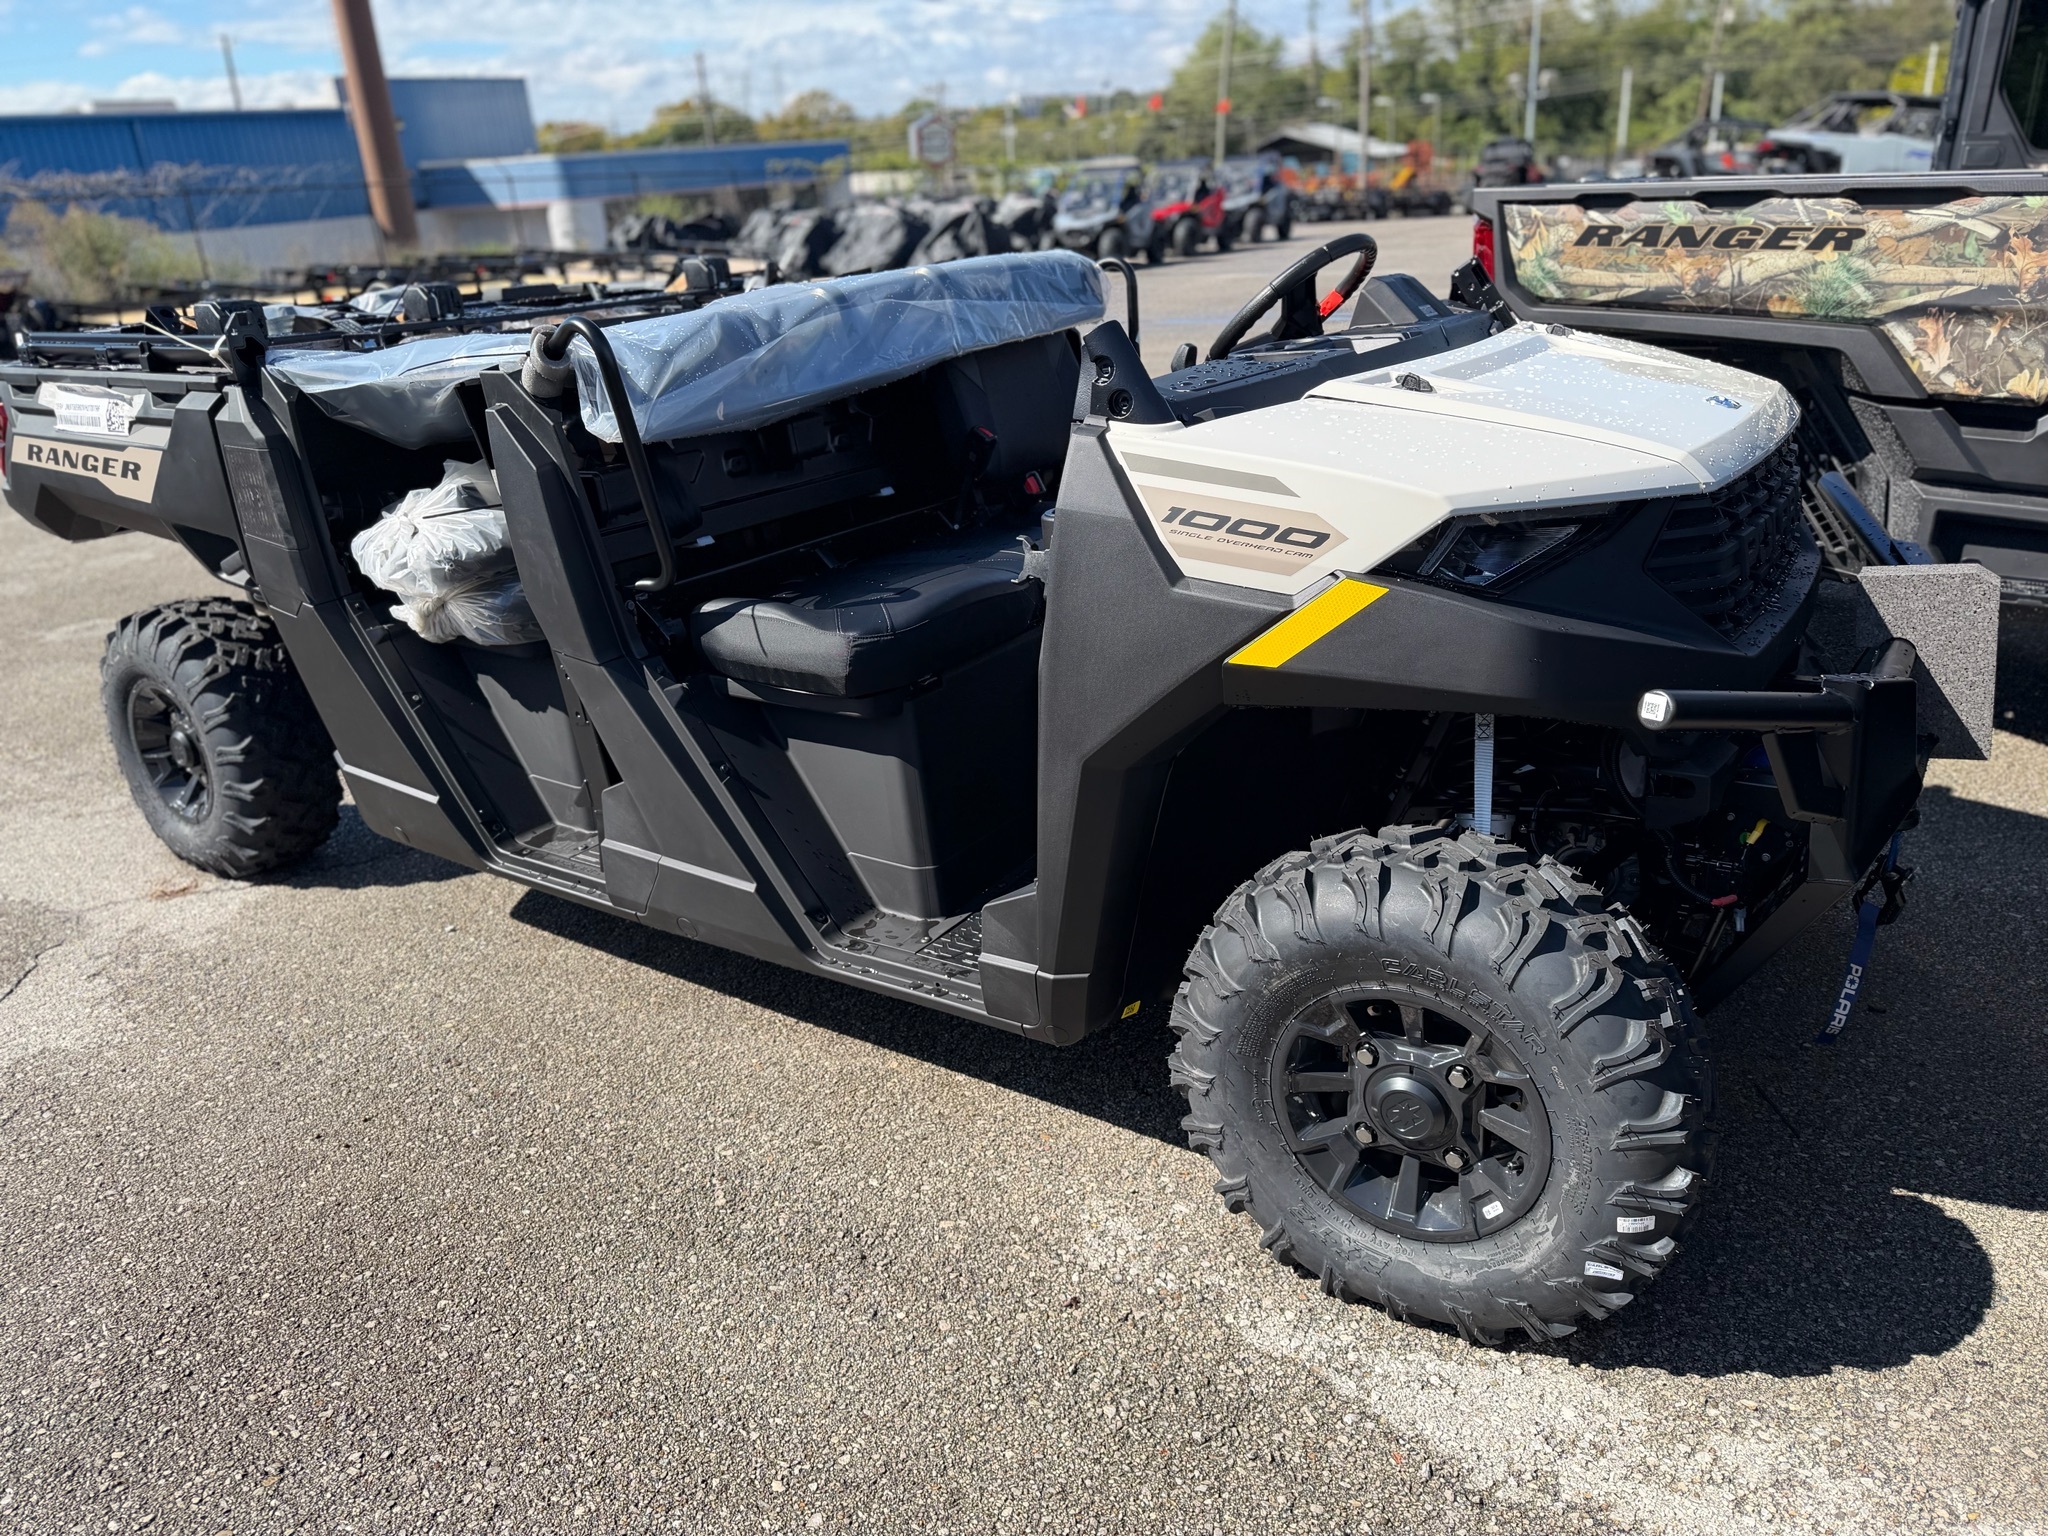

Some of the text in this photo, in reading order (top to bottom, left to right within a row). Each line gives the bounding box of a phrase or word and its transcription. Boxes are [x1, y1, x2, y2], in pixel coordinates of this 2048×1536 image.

[1573, 224, 1867, 251] RANGER
[27, 443, 142, 481] RANGER
[1161, 506, 1331, 549] 1000
[1169, 528, 1315, 559] SINGLE OVERHEAD CAM
[1381, 958, 1547, 1055] CARLSTAR
[1825, 963, 1862, 1035] POLARIS
